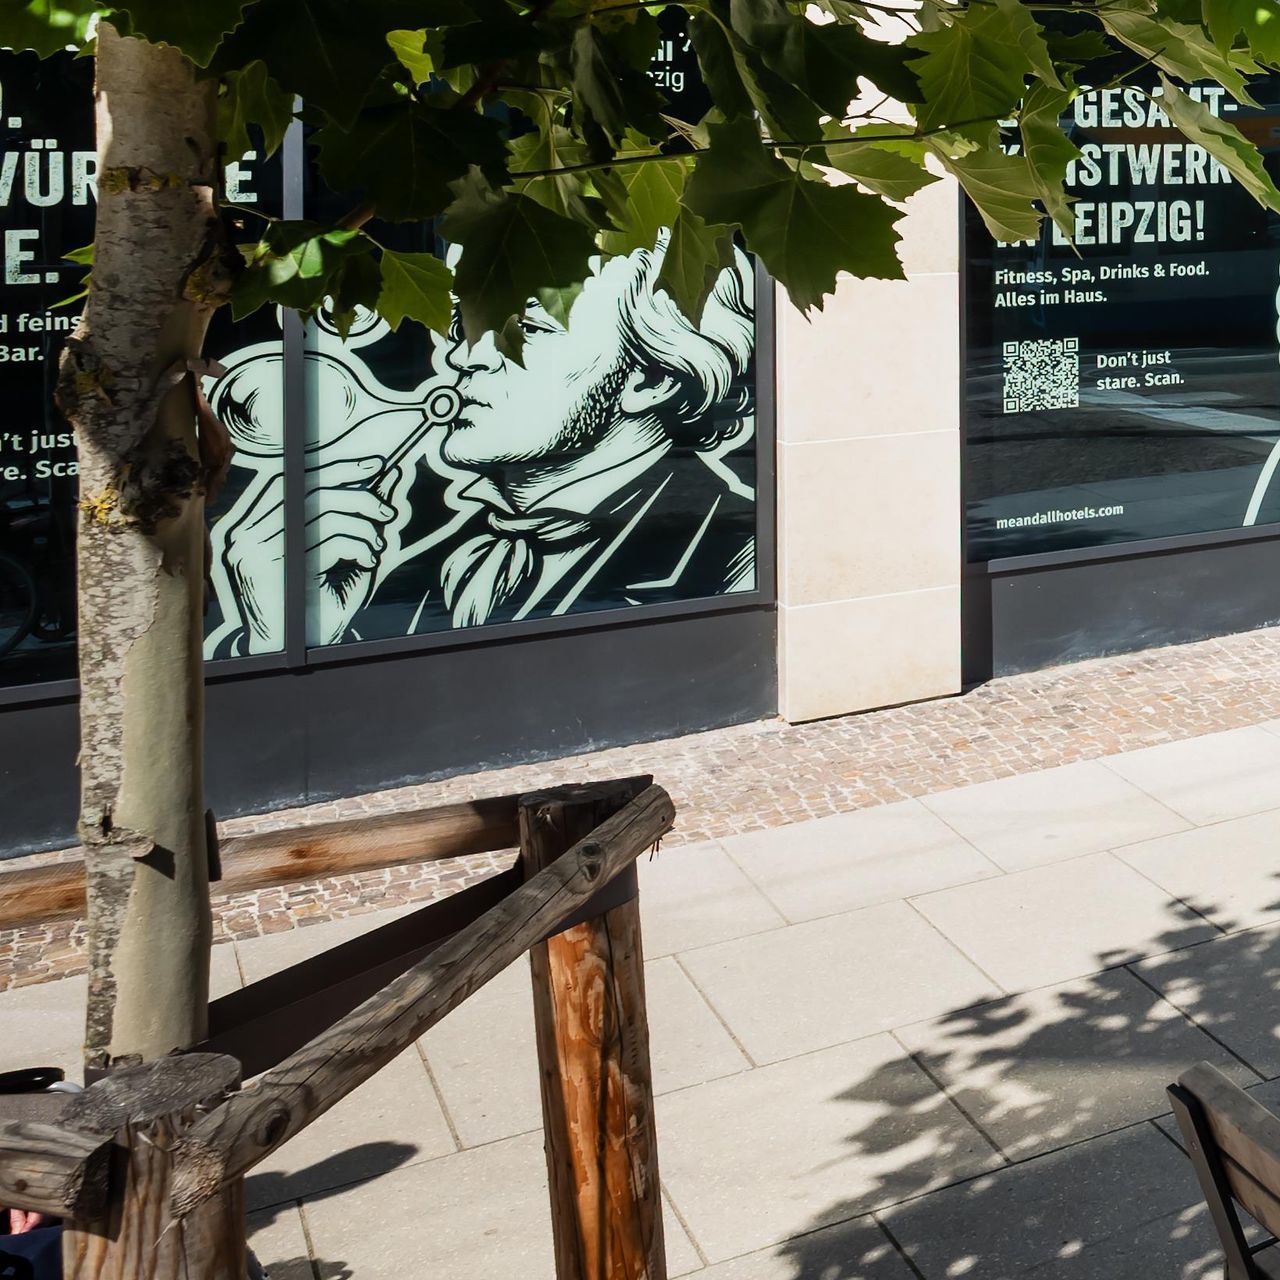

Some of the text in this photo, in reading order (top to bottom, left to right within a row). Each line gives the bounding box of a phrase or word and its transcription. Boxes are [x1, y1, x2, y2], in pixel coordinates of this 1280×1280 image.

[1074, 84, 1239, 130] GESAT-
[994, 261, 1211, 287] Fitness, Spa, Drinks & Food.
[994, 289, 1108, 308] Alles im Haus.
[1096, 350, 1172, 369] Don’t just
[1096, 372, 1186, 391] stare. Scan.
[996, 504, 1125, 530] meandallhotels.com
